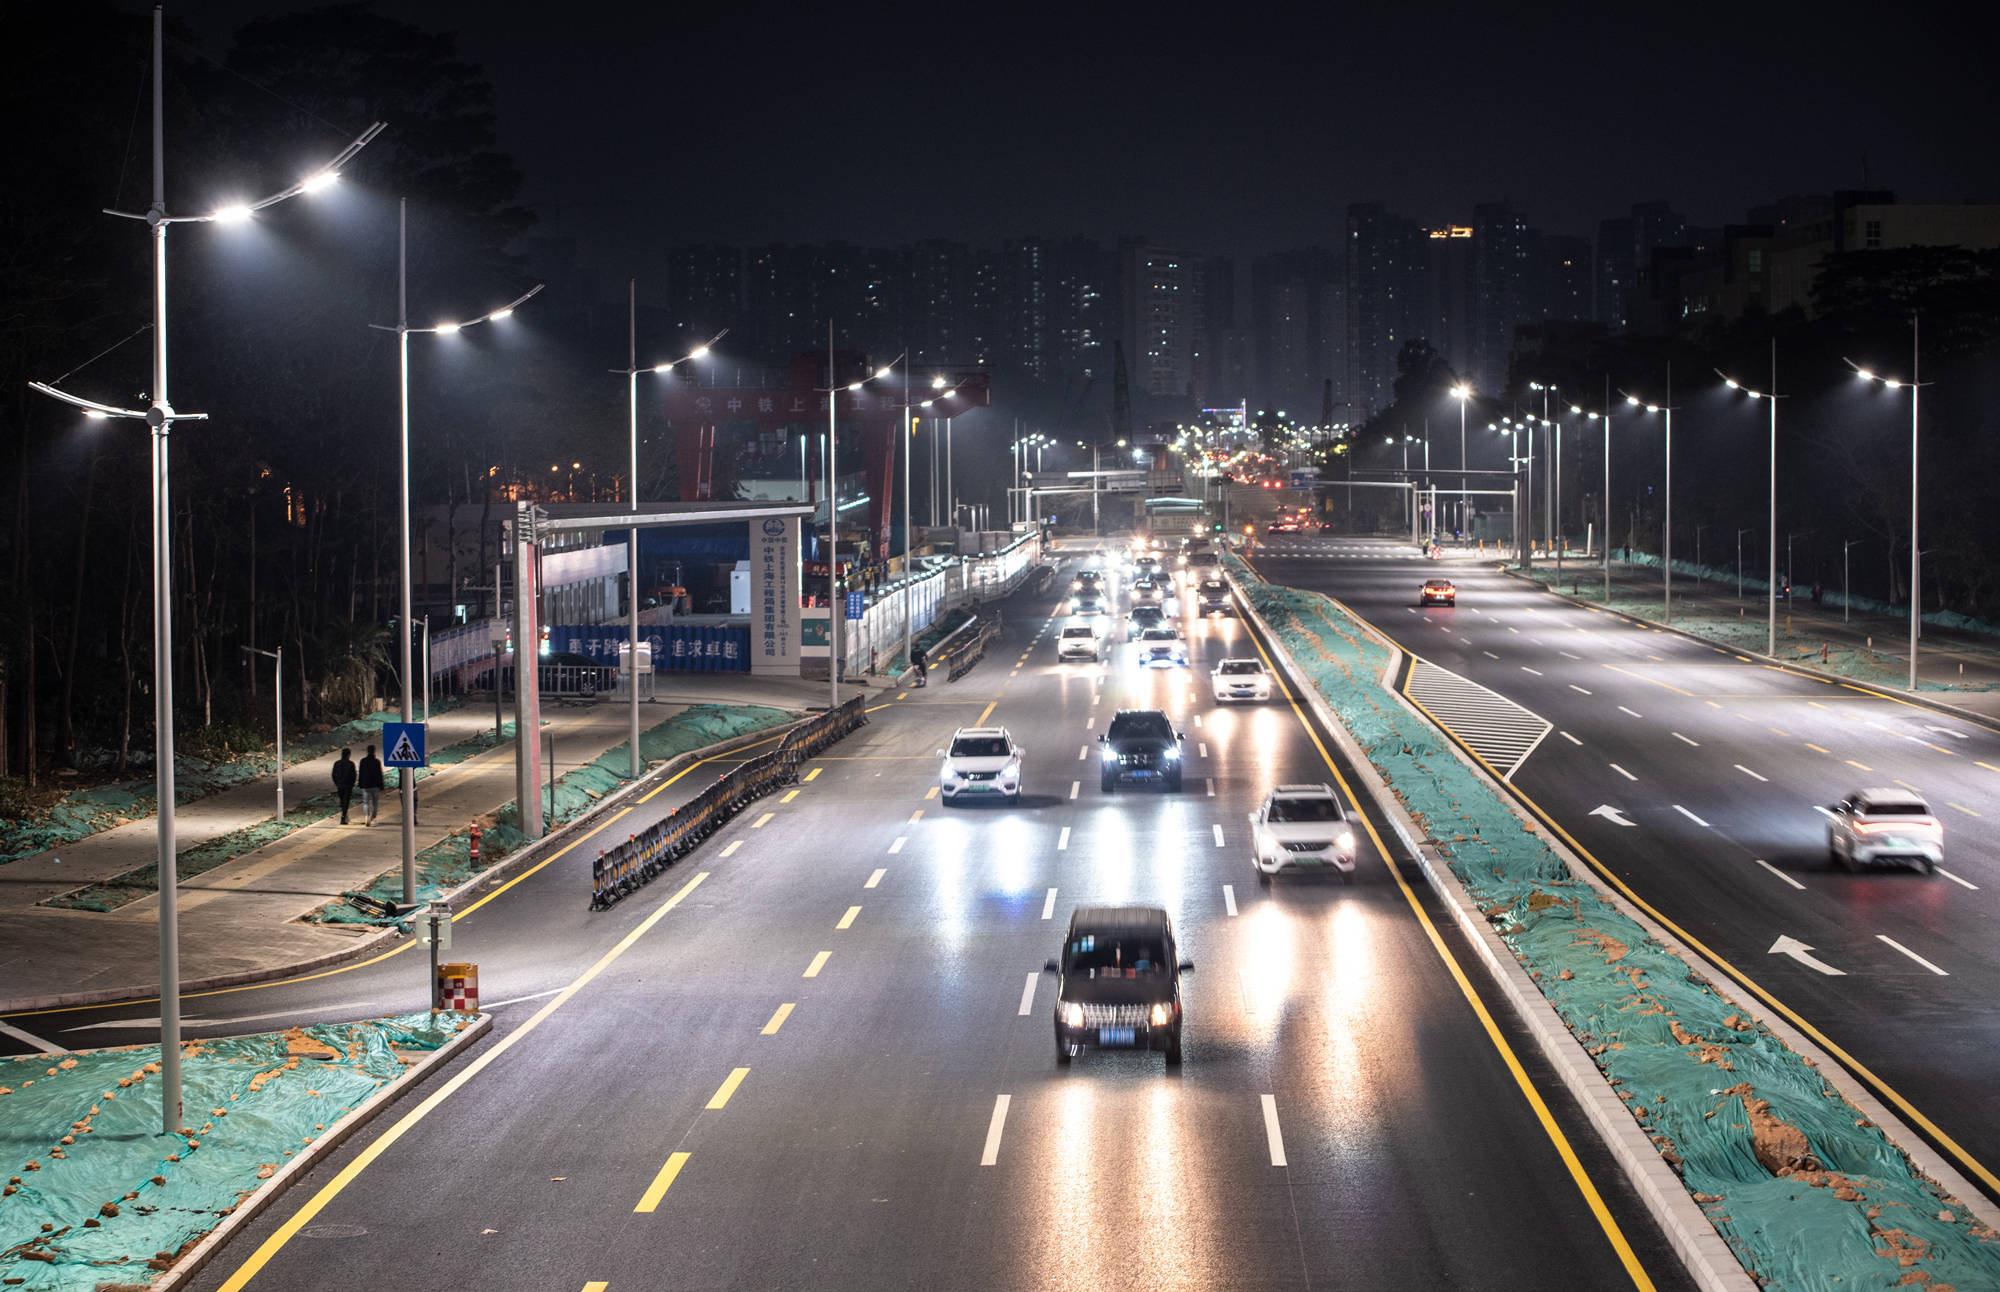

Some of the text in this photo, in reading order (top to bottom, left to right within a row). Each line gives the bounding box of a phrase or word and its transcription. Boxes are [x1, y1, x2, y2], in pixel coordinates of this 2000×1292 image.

[764, 546, 775, 656] 中铁上海工程局集团有限公司
[569, 638, 630, 656] 勇于跨
[672, 639, 738, 659] 追求卓越
